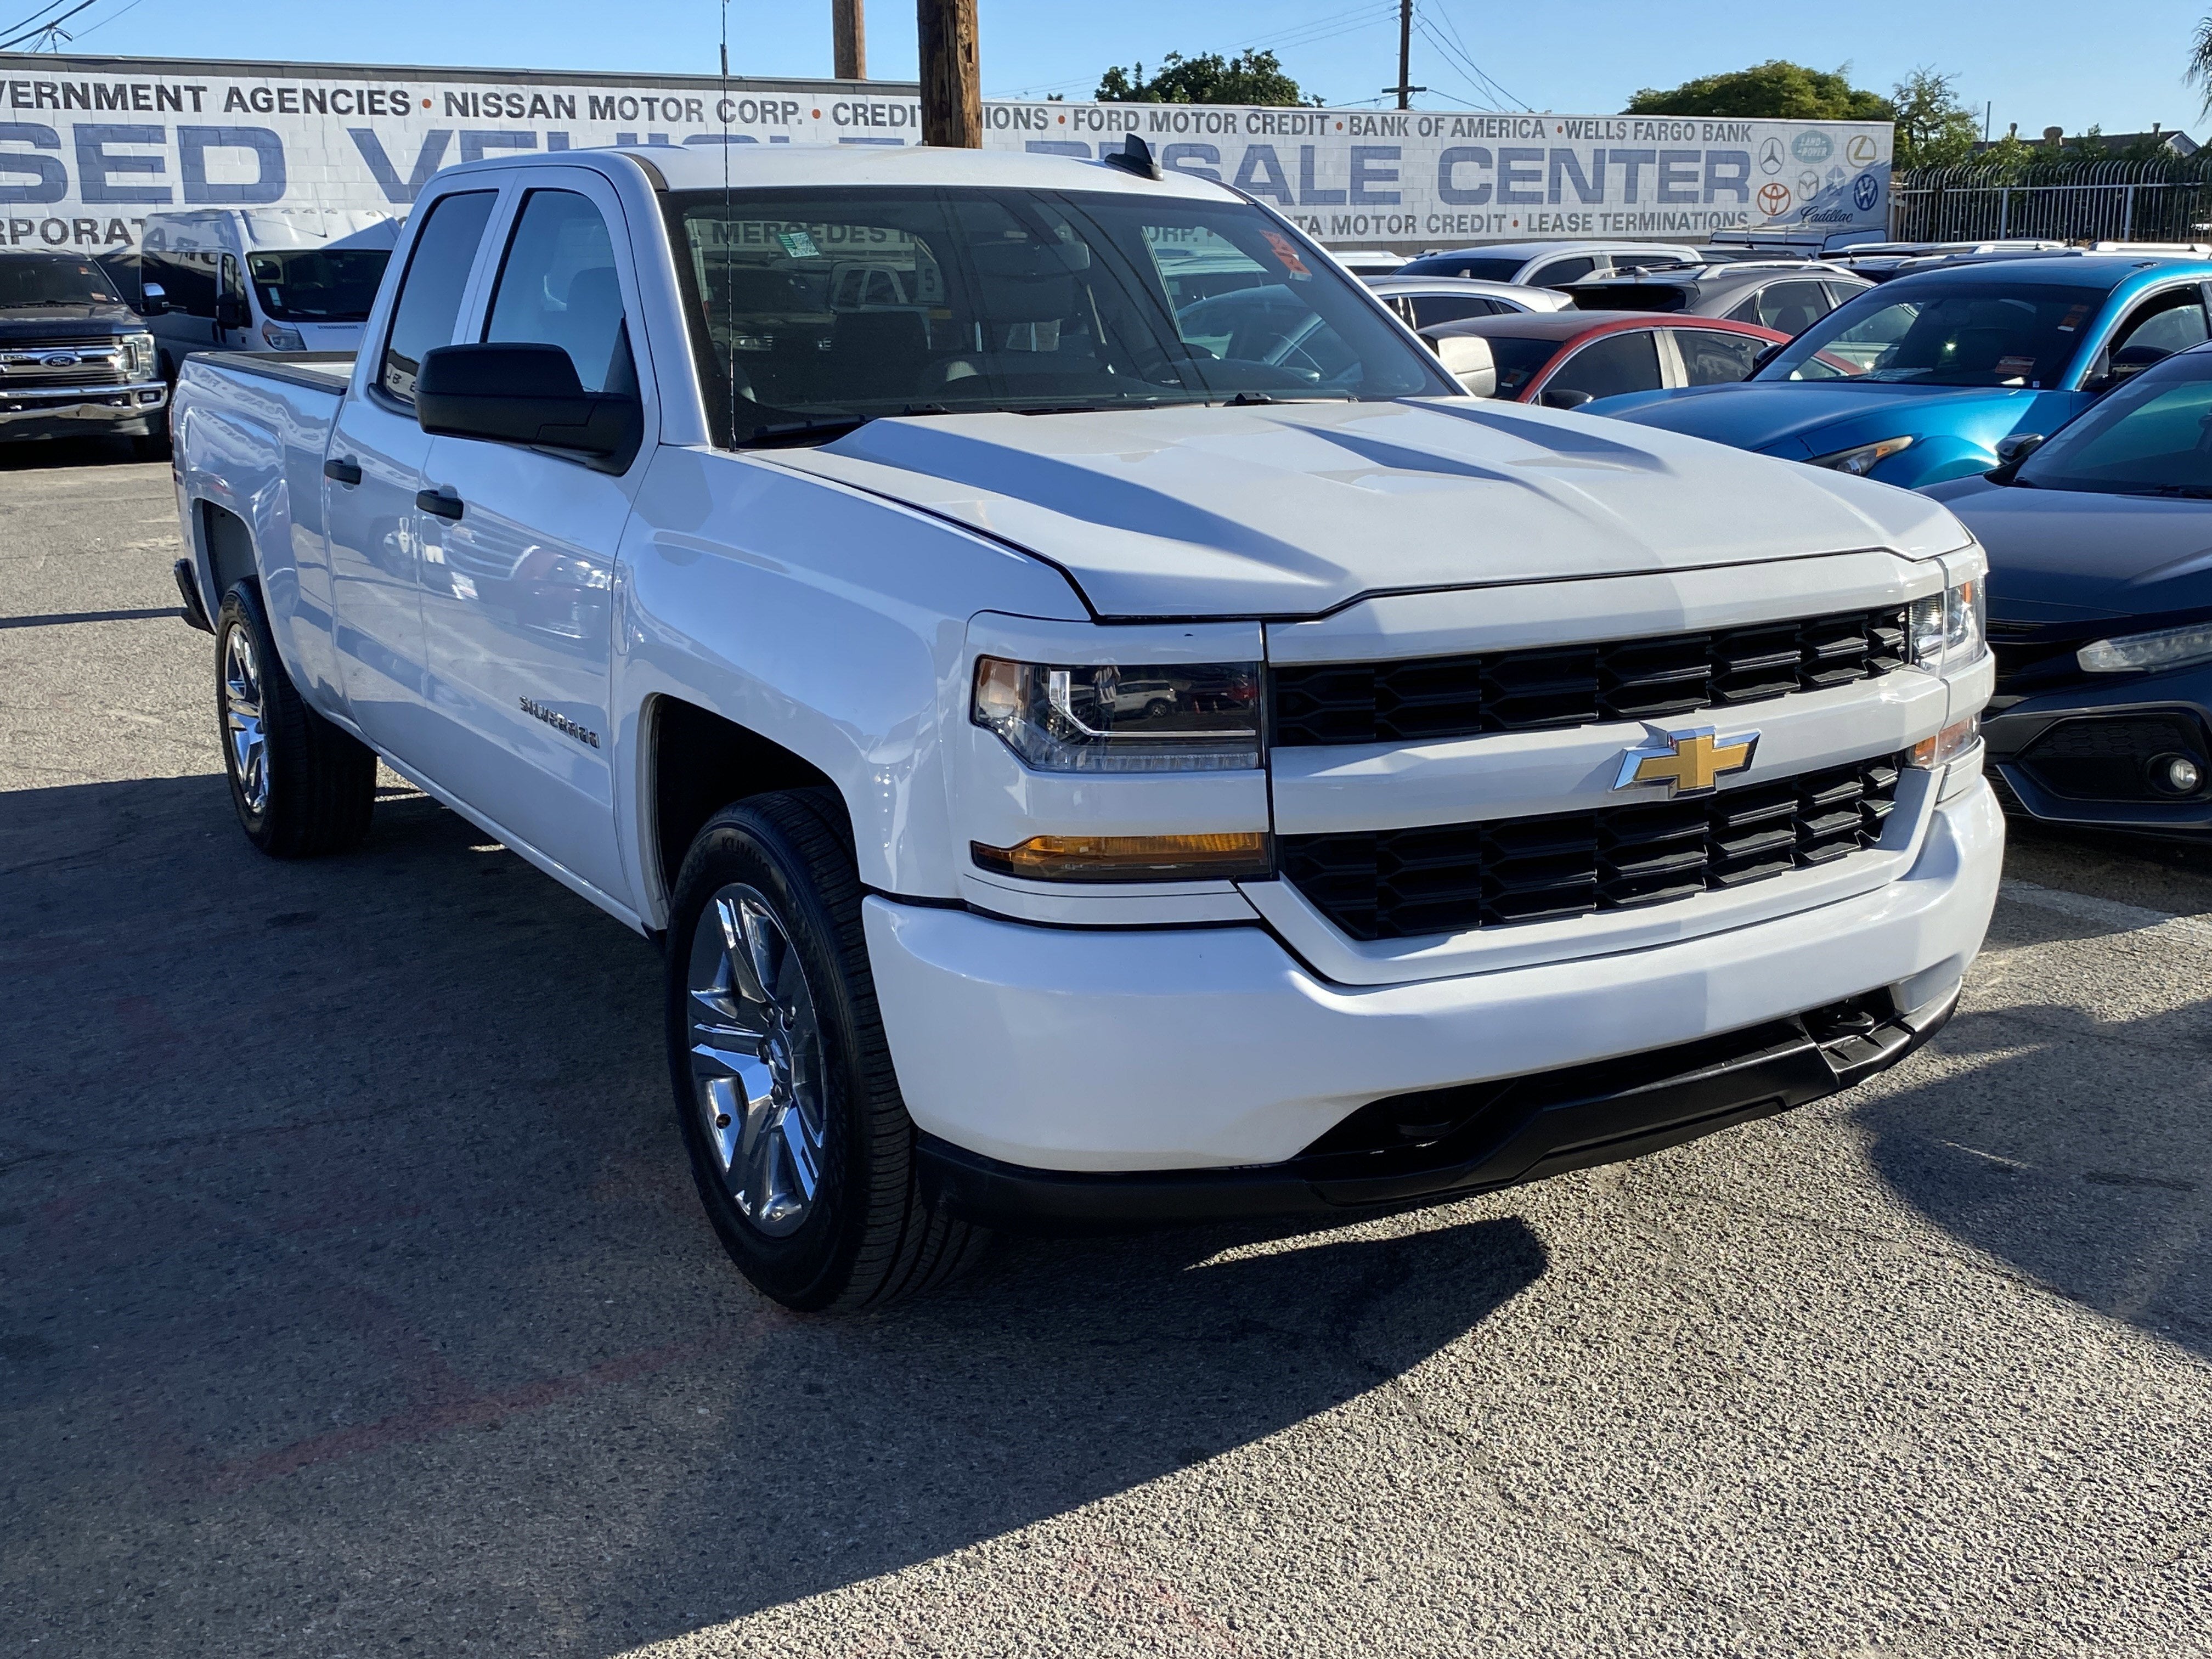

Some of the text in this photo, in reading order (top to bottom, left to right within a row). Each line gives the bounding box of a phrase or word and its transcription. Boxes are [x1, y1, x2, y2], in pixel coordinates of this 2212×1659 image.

[0, 80, 207, 112] ERNMENT
[224, 86, 411, 116] AGENCIES
[444, 91, 576, 120] NISSAN
[589, 95, 704, 122] MOTOR
[716, 98, 803, 125] CORP.
[832, 101, 922, 127] CREDI
[1073, 109, 1140, 131] FORD
[1149, 111, 1238, 134] MOTOR
[1245, 113, 1330, 135] CREDIT
[1349, 115, 1409, 137] BANK
[1418, 116, 1445, 137] OF
[1451, 117, 1545, 138] AMERICA
[1564, 120, 1627, 140] WELLS
[1633, 122, 1695, 141] FARGO
[1702, 123, 1752, 142] BANK
[1438, 146, 1751, 206] CENTER
[1331, 215, 1417, 236] MOTOR
[1426, 214, 1506, 234] CREDIT
[1527, 213, 1593, 233] LEASE
[1599, 211, 1748, 232] TERMINATIONS
[1800, 206, 1853, 223] Cadillac
